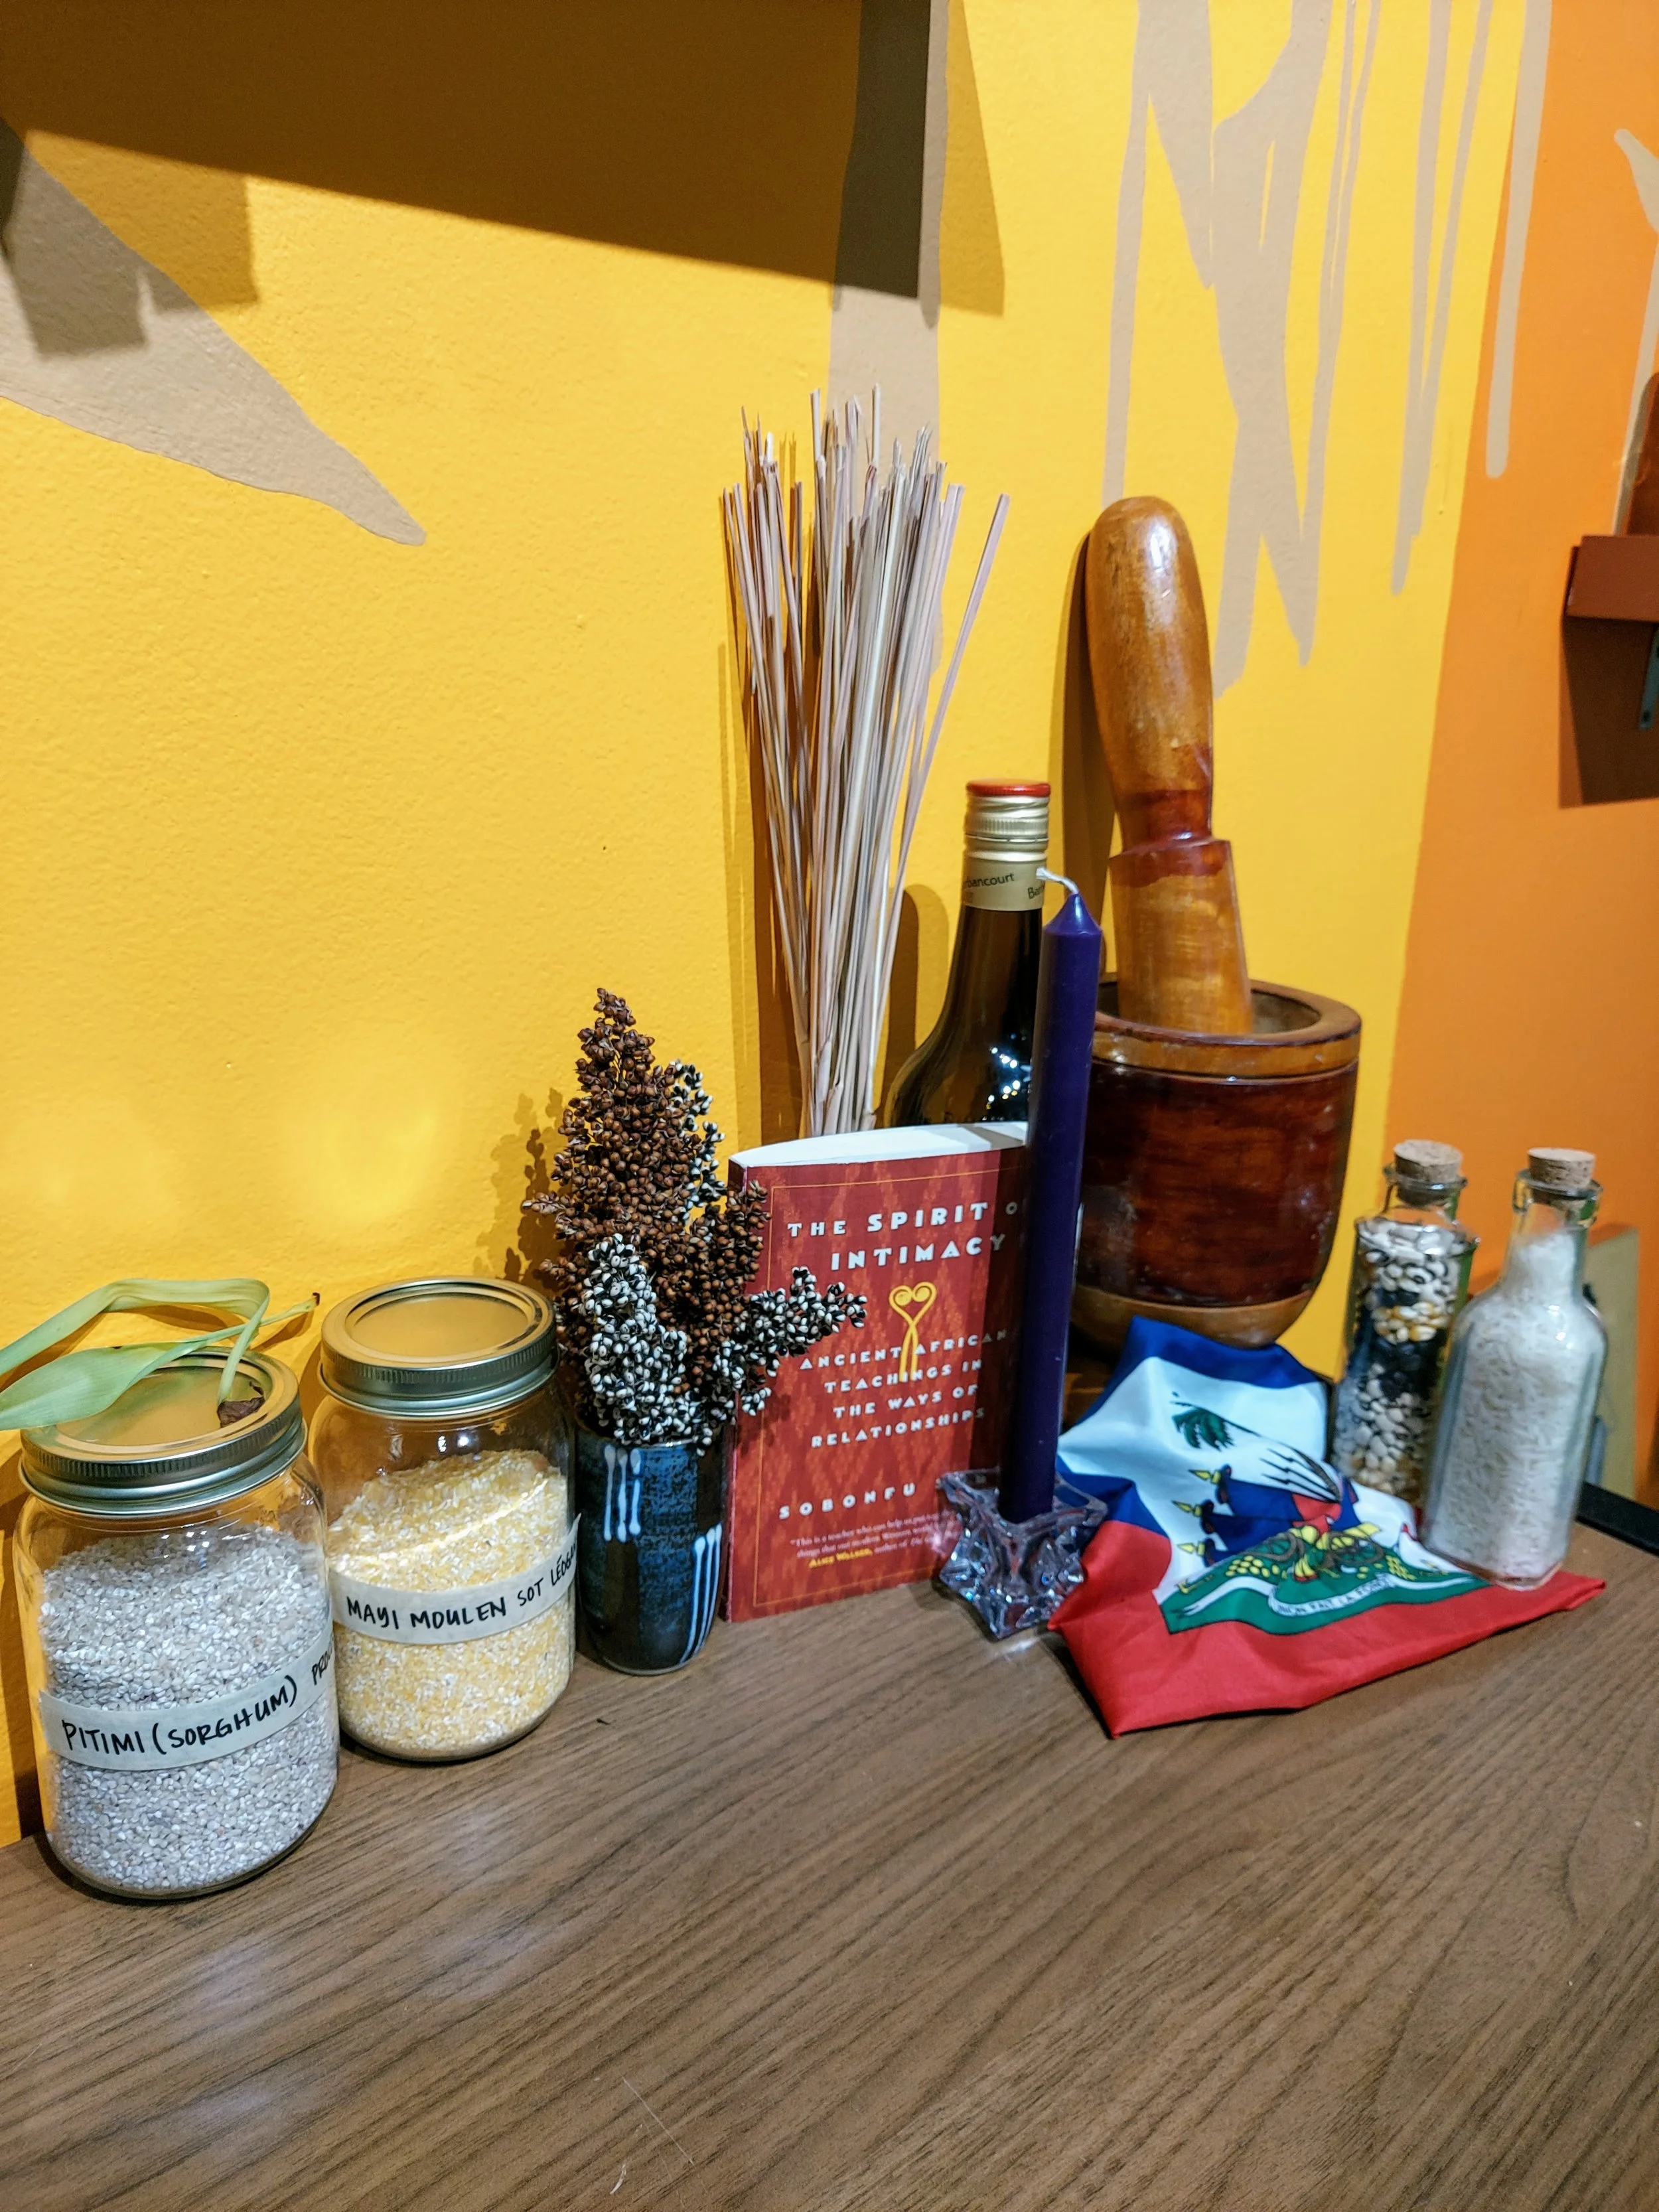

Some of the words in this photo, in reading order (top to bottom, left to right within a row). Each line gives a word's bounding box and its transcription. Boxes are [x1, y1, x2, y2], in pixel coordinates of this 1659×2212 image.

[787, 1220, 847, 1237] THE
[867, 1201, 989, 1232] SPIRIT
[1006, 1201, 1017, 1215] O
[831, 1234, 1005, 1270] INTIMACY
[800, 1346, 902, 1370] ANCIENT
[914, 1329, 1006, 1355] AFRICAN
[824, 1364, 952, 1394] TEACHINGS
[962, 1359, 982, 1372] IN
[833, 1402, 876, 1419] THE
[888, 1391, 942, 1410] WAYS
[952, 1384, 979, 1399] OF
[811, 1408, 985, 1448] RELATIONSHIPS
[779, 1482, 916, 1520] SOBONFU
[346, 1595, 399, 1629] MAYI
[409, 1596, 507, 1629] MOULEN
[517, 1577, 544, 1607] SOT
[62, 1719, 145, 1755] PITIMI
[152, 1674, 298, 1755] (SORGHUM)
